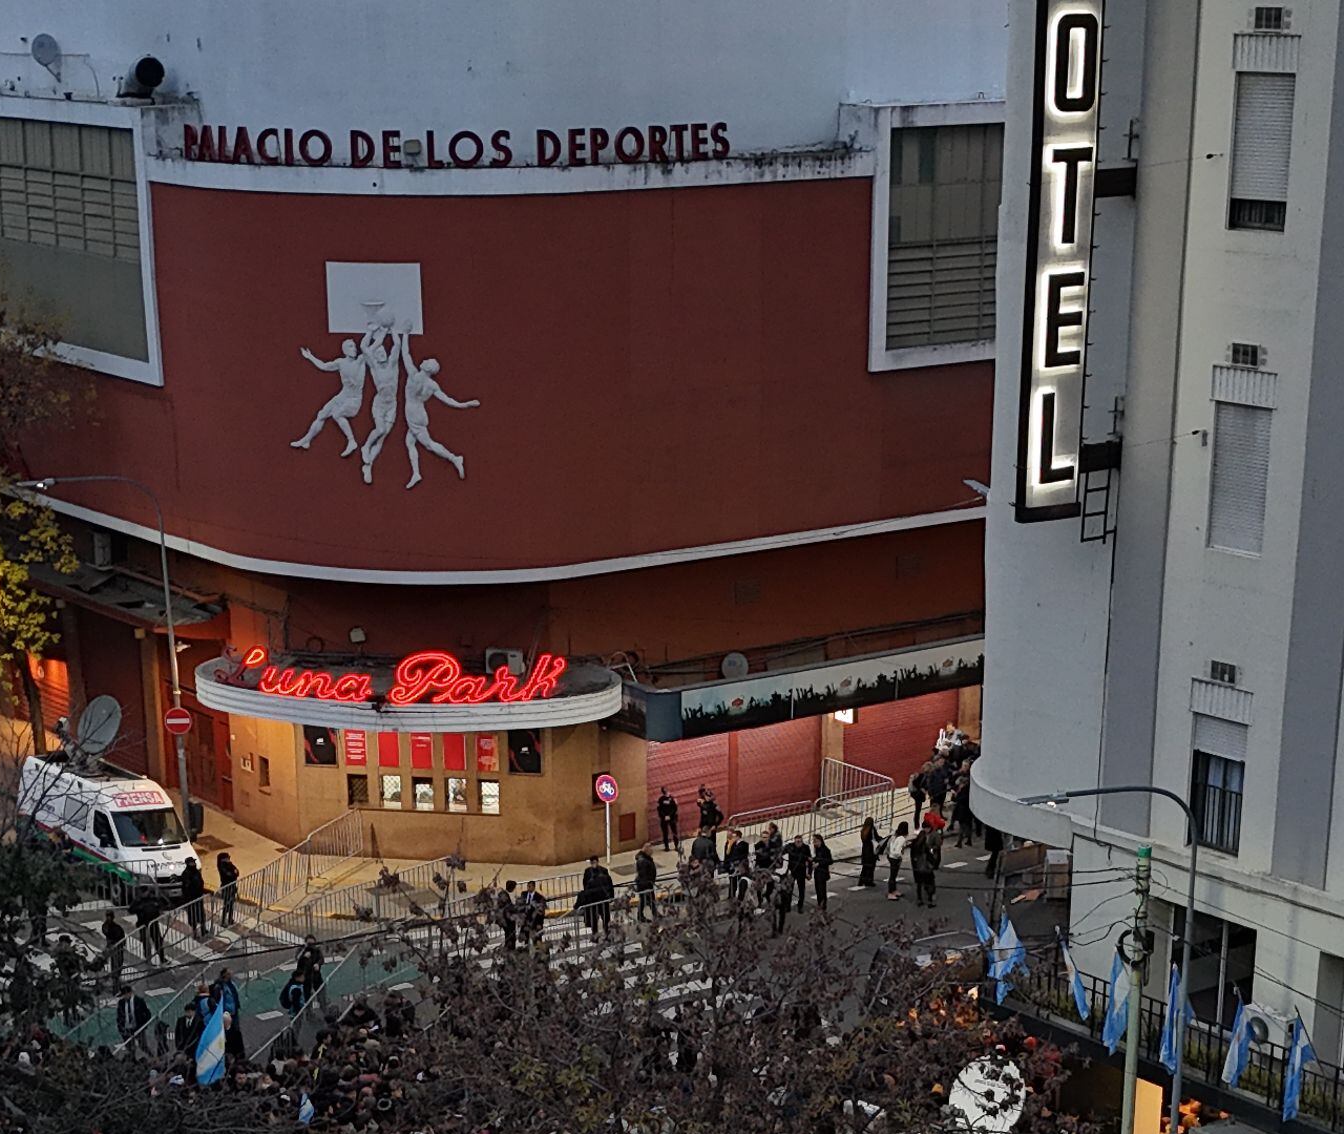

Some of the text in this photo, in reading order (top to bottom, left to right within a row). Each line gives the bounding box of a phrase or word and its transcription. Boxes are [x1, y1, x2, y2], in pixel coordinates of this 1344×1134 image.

[184, 122, 730, 169] PALACIO DE LOS DEPORTES
[389, 651, 568, 704] Park
[115, 792, 164, 807] PRENSA
